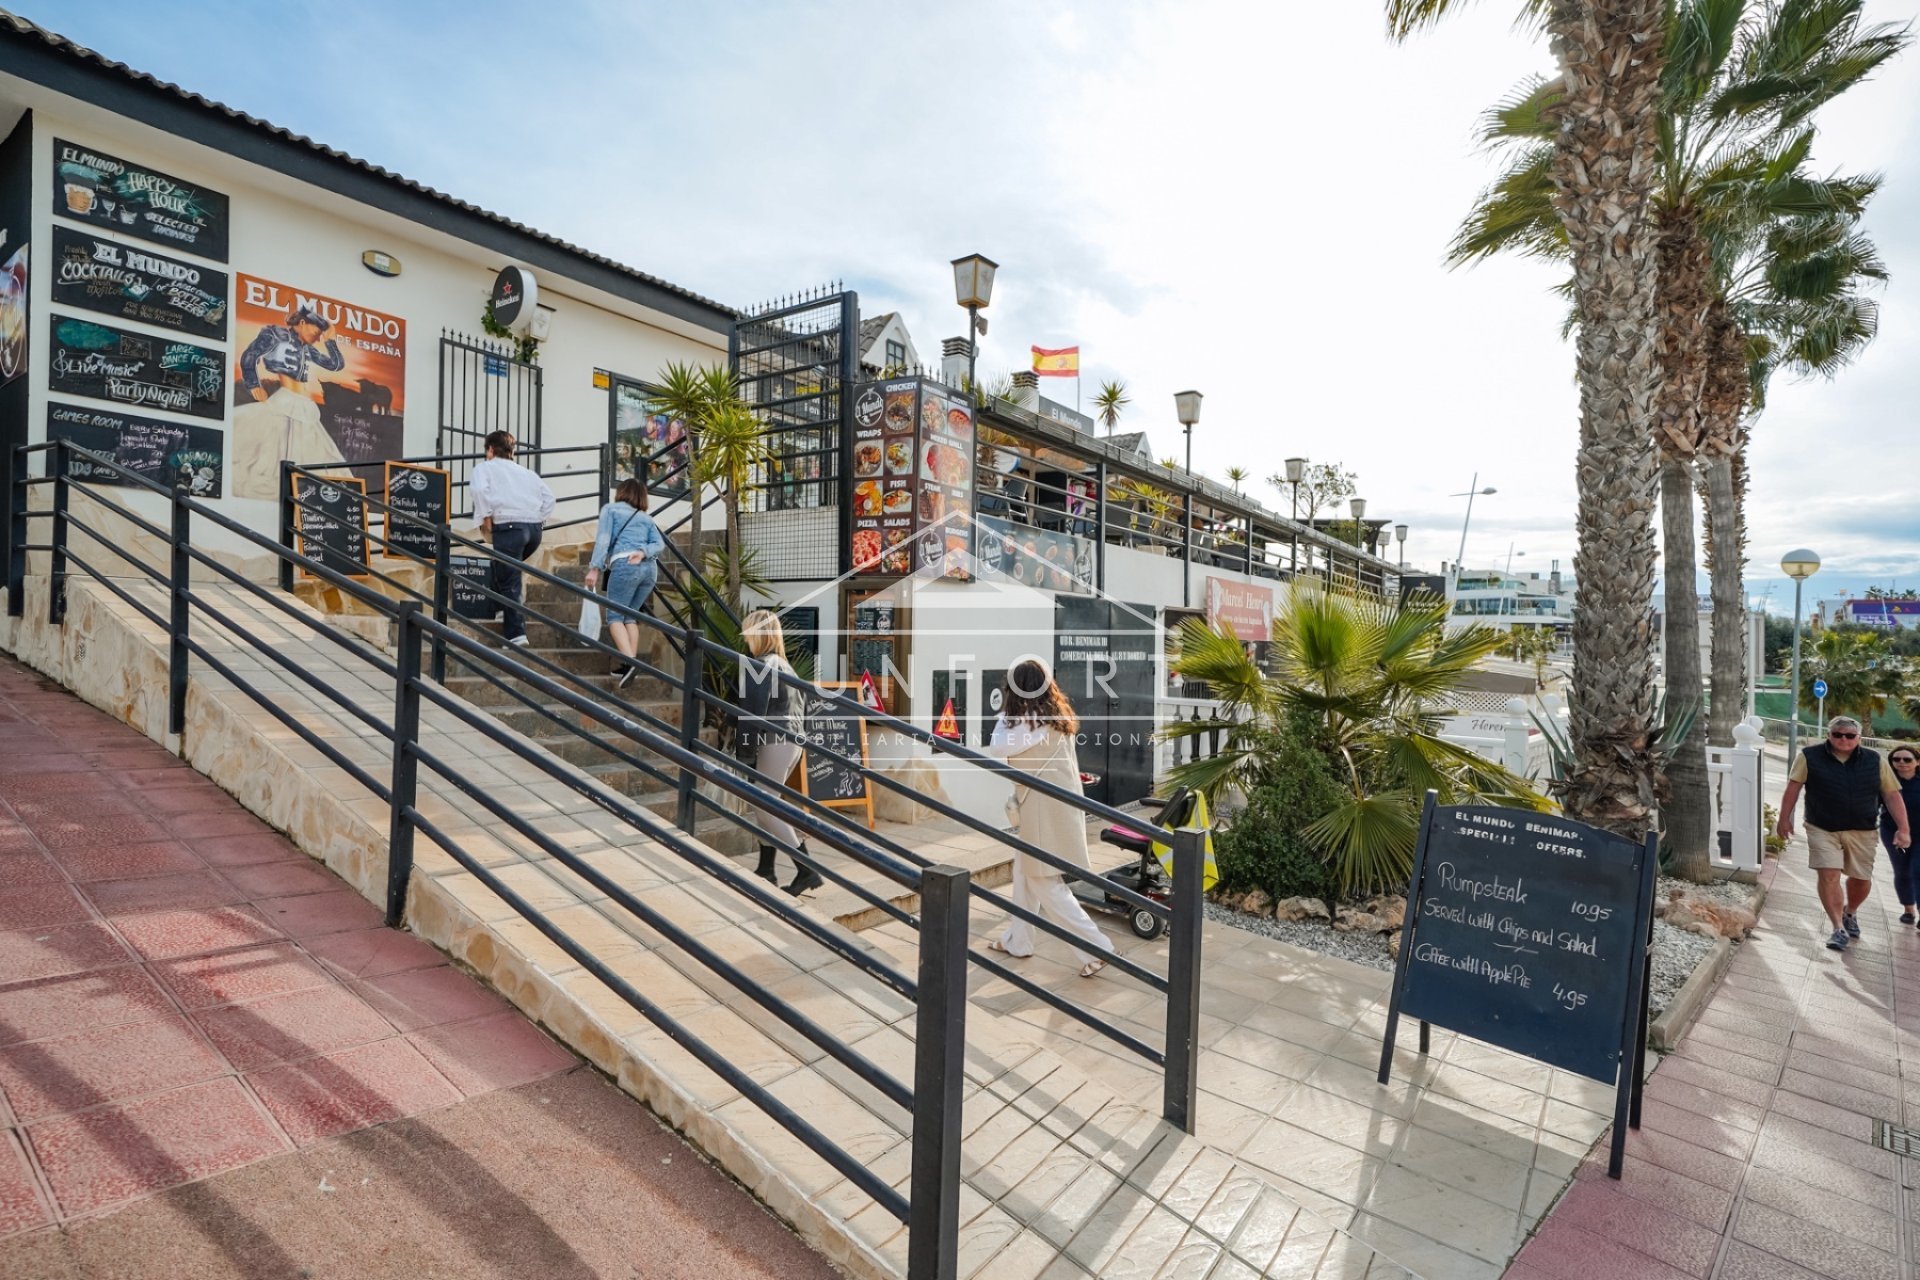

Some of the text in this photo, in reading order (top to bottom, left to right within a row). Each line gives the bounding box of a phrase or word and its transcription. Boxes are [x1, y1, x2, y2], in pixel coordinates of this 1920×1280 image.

[82, 154, 125, 175] MUNDO
[128, 172, 178, 195] HAPPY
[144, 212, 199, 233] SELECTED
[93, 241, 122, 266] EL
[126, 250, 200, 286] MUNDO
[495, 292, 520, 309] Heineken
[244, 279, 400, 350] EL MUNDO
[165, 345, 196, 355] LARGE
[335, 333, 402, 358] DE ESPAÑA
[161, 355, 219, 368] DANCE FLOOR
[110, 379, 147, 404] Party
[147, 381, 191, 408] Nights
[886, 382, 917, 393] CHICKEN
[53, 410, 123, 431] GAMES ROOM
[1060, 411, 1083, 430] Mundo
[856, 429, 882, 438] WRAPS
[890, 480, 907, 488] FISH
[857, 518, 911, 528] PIZZA SALADS
[826, 717, 849, 731] Music
[1455, 811, 1470, 822] EL
[1570, 900, 1613, 923] 10.95
[1551, 981, 1590, 1011] 4.95
